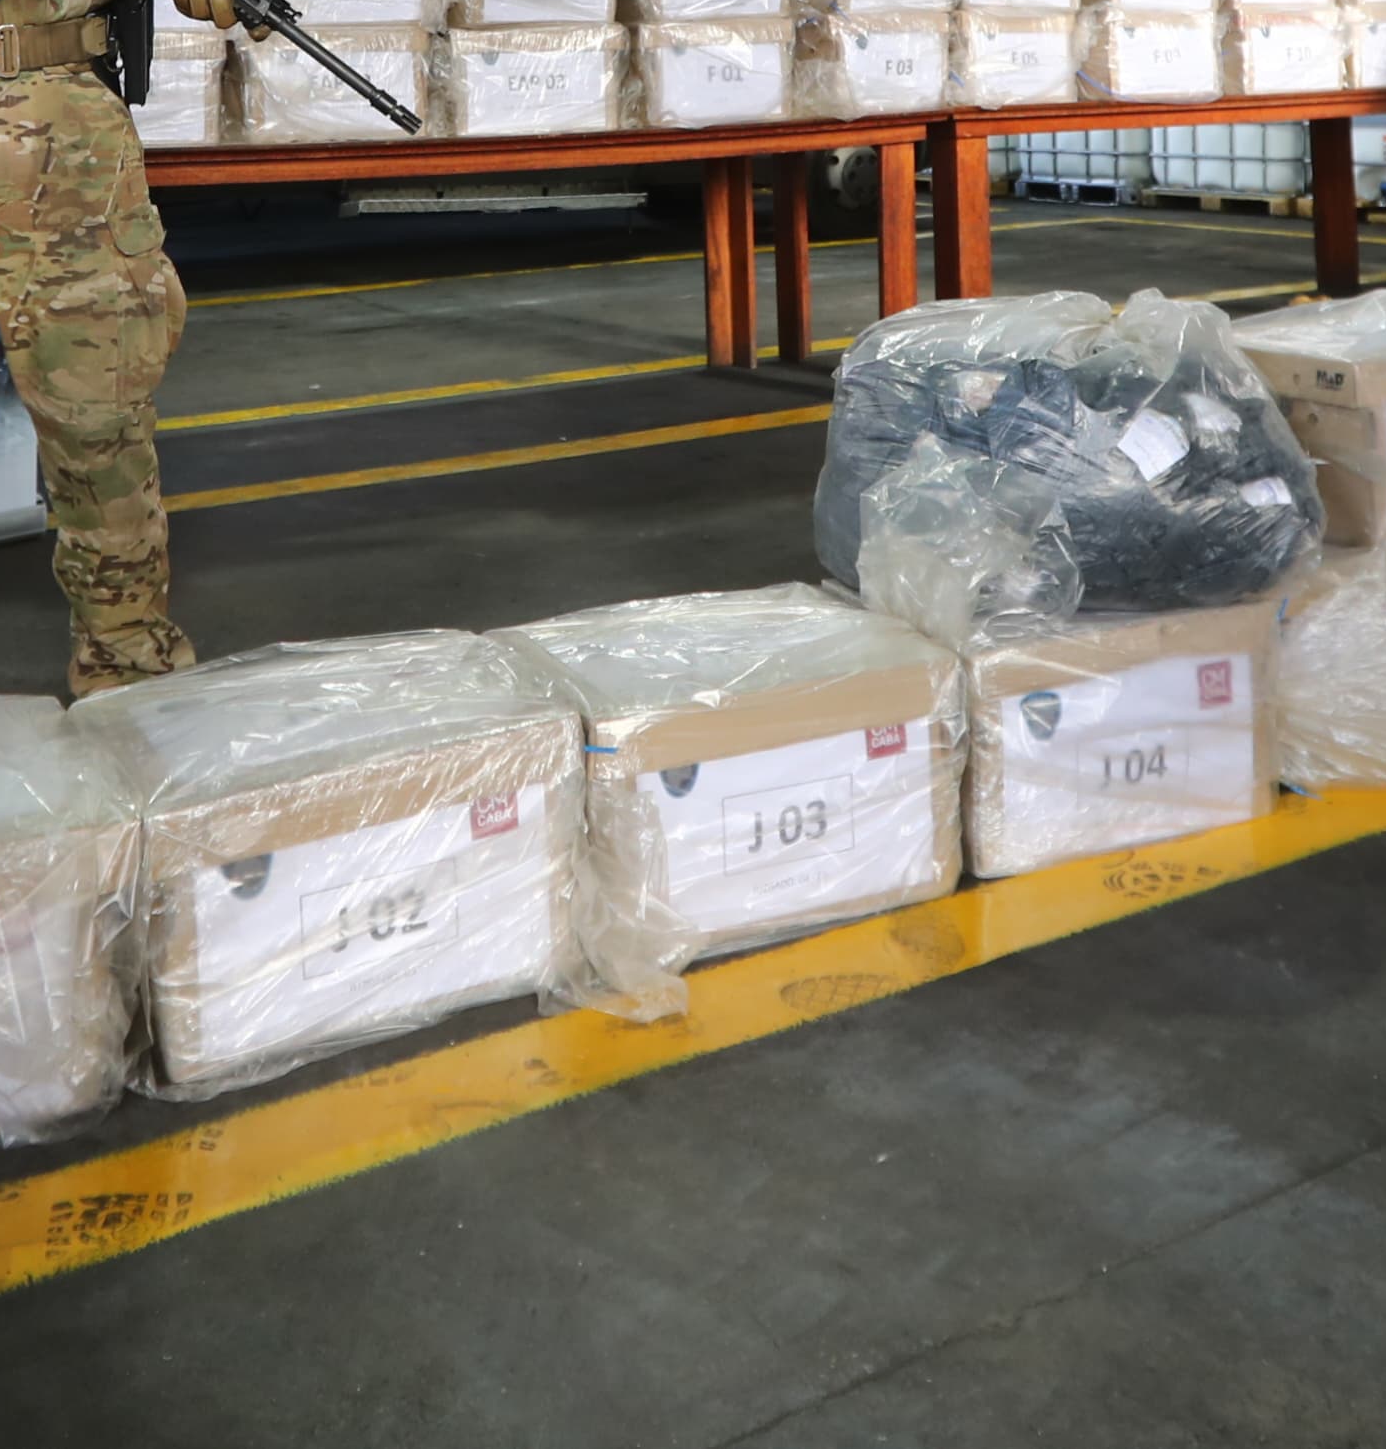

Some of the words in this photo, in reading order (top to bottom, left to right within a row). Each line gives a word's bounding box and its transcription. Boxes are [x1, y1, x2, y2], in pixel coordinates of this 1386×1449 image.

[706, 66, 716, 83] F
[721, 64, 744, 83] 01
[885, 61, 893, 76] F
[896, 58, 914, 76] 03
[871, 734, 901, 749] CABA
[1099, 756, 1111, 791] J
[1124, 745, 1168, 785] 04
[748, 812, 763, 854] J
[778, 799, 828, 846] 03
[368, 888, 428, 942] 02
